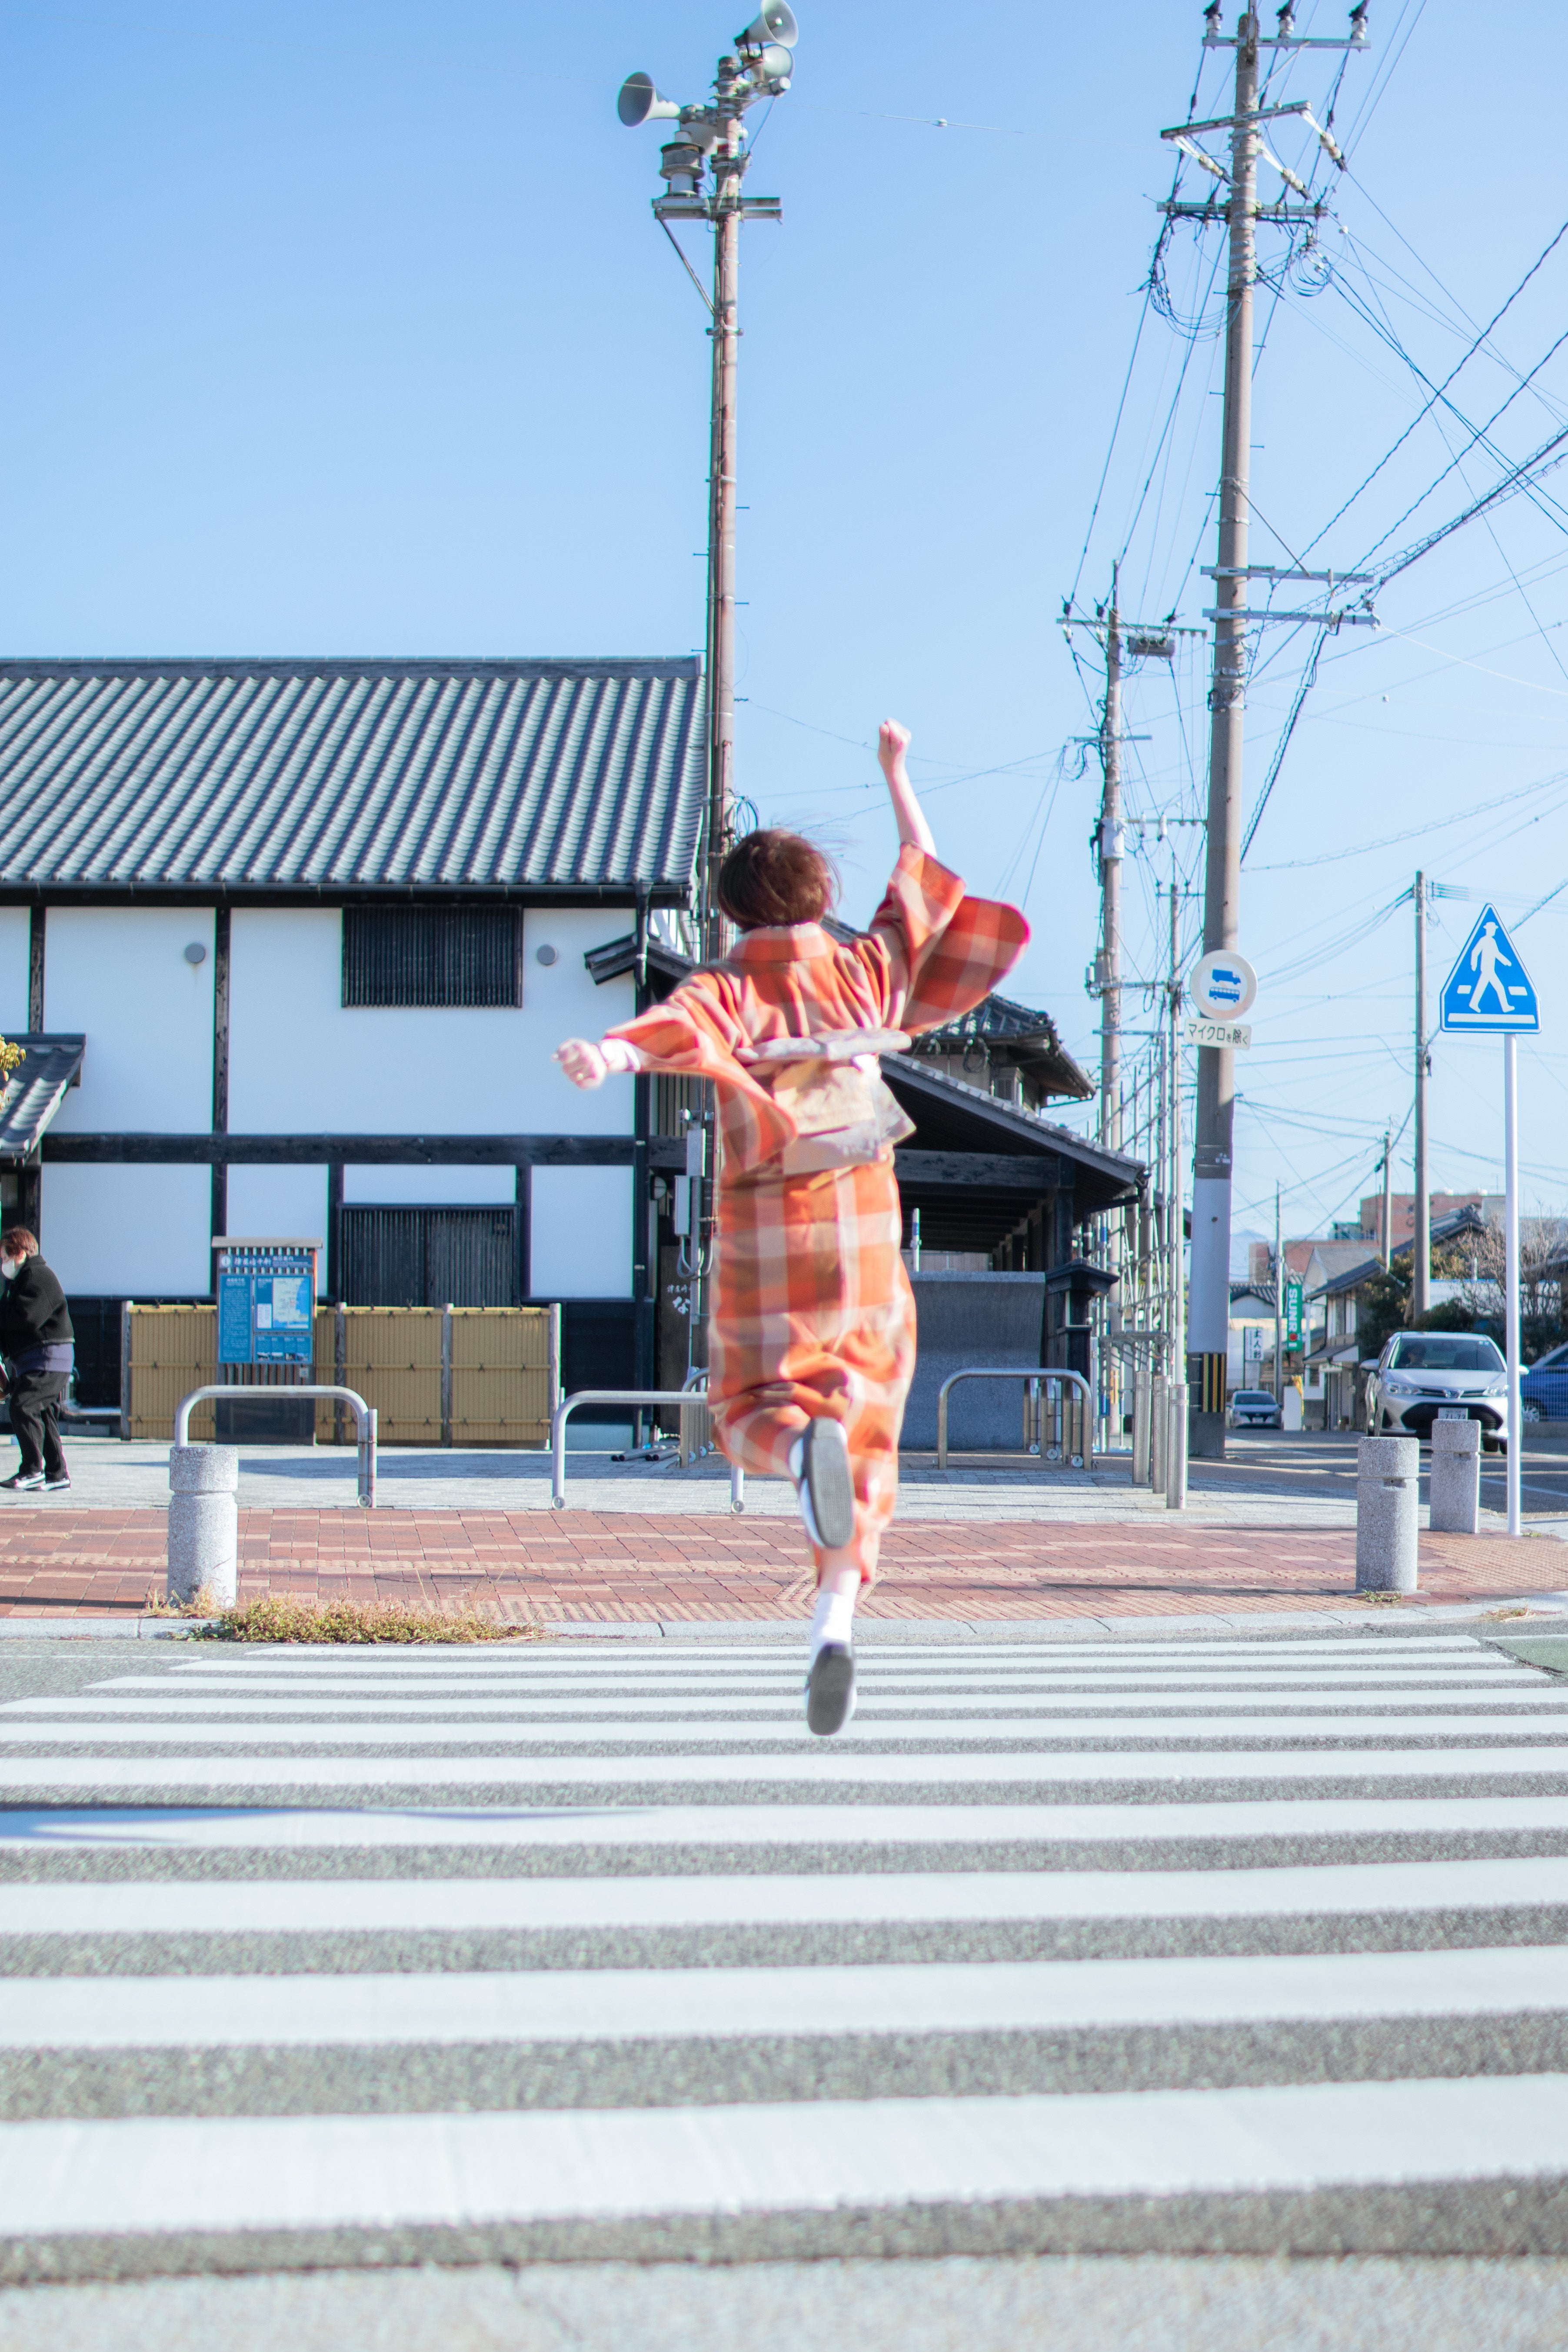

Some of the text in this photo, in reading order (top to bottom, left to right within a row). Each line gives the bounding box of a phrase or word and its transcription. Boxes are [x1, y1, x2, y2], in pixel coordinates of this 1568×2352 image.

[1188, 1024, 1248, 1045] マイクロを除く
